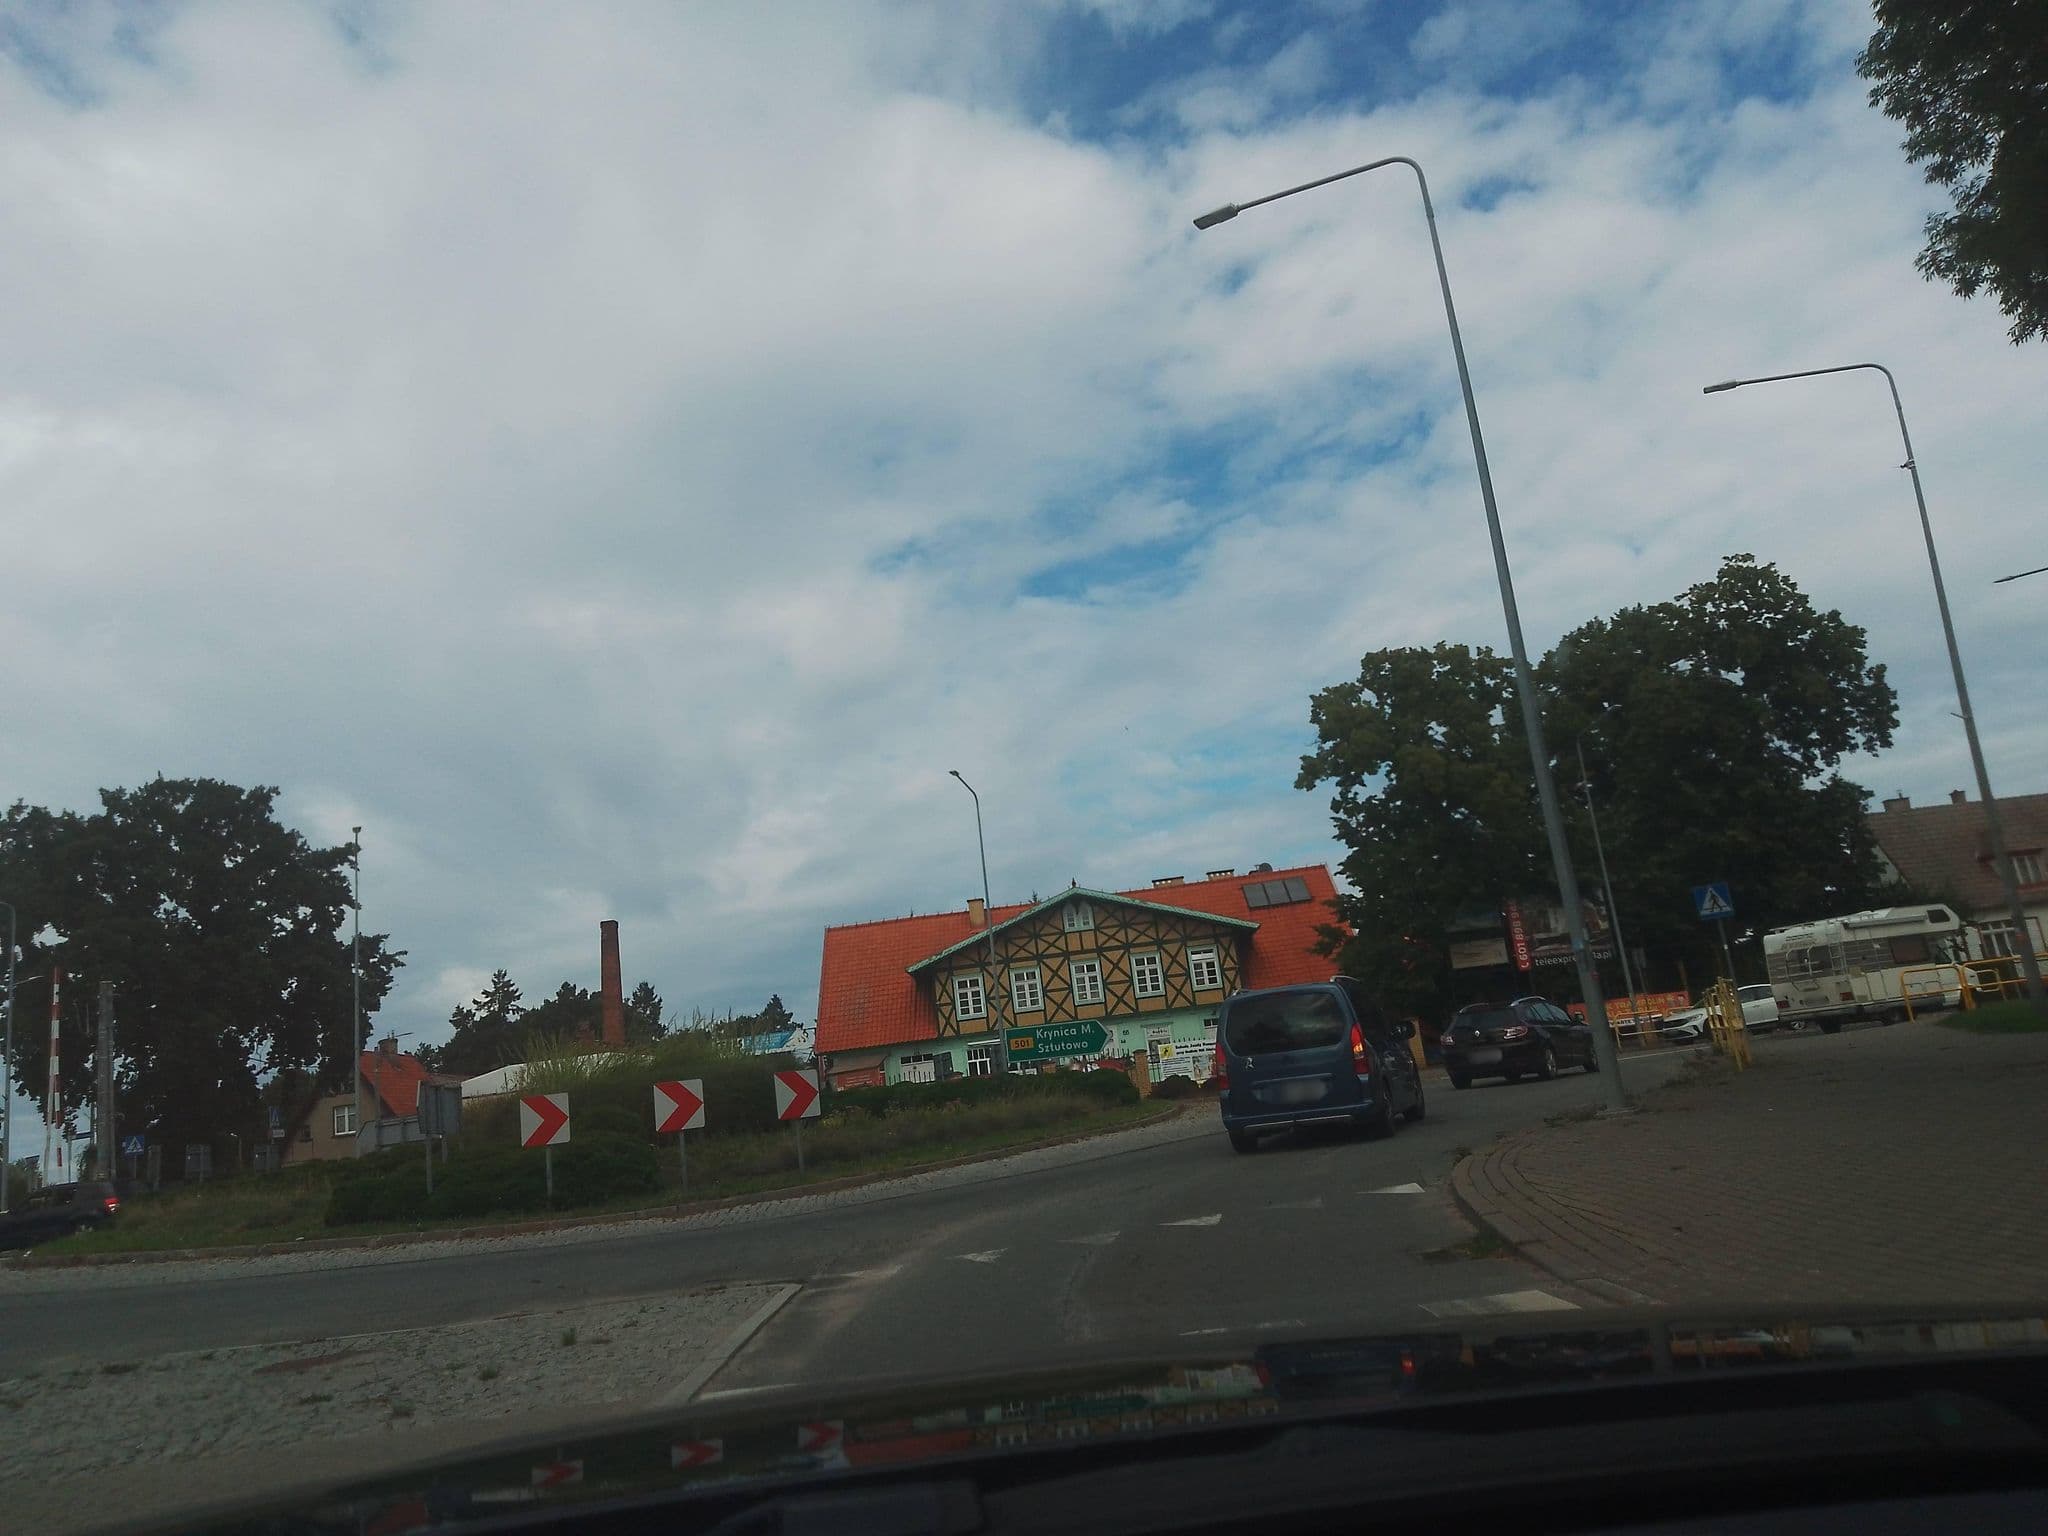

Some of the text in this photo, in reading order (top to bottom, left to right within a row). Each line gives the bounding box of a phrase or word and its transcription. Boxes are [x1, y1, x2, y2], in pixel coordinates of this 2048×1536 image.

[1036, 1023, 1095, 1041] Krynica M.
[1014, 1039, 1030, 1049] 501
[1038, 1041, 1089, 1053] Sztutowo
